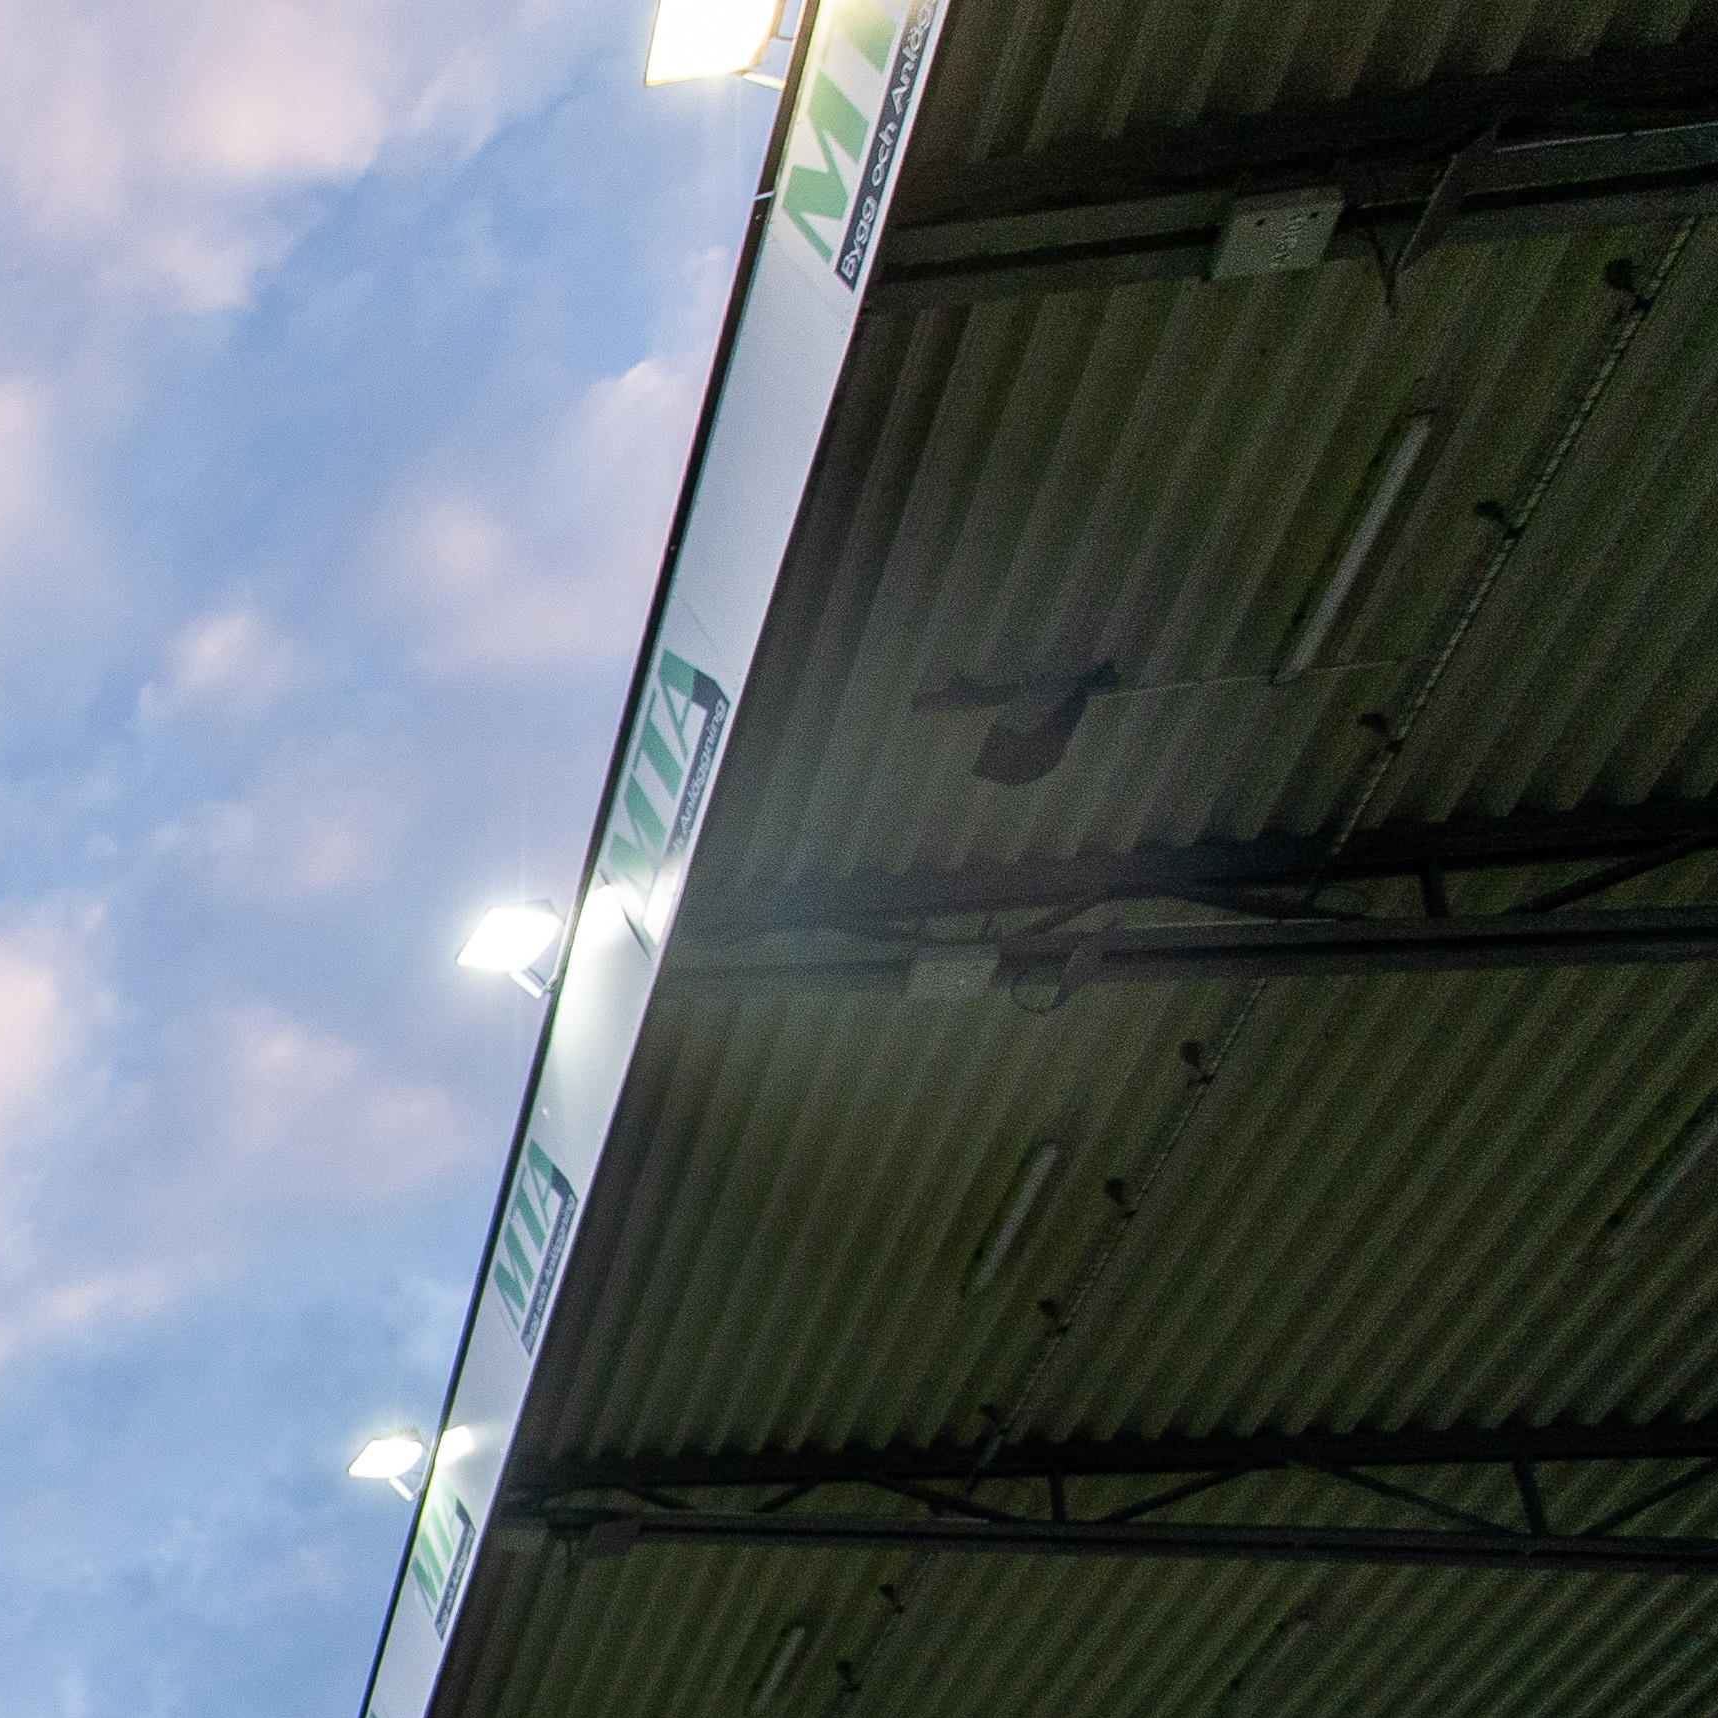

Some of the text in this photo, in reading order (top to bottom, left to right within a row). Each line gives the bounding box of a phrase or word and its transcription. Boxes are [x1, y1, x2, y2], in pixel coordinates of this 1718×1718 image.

[782, 0, 898, 263] MT
[840, 0, 933, 280] Bygg och Anläg
[494, 1138, 553, 1332] MTA
